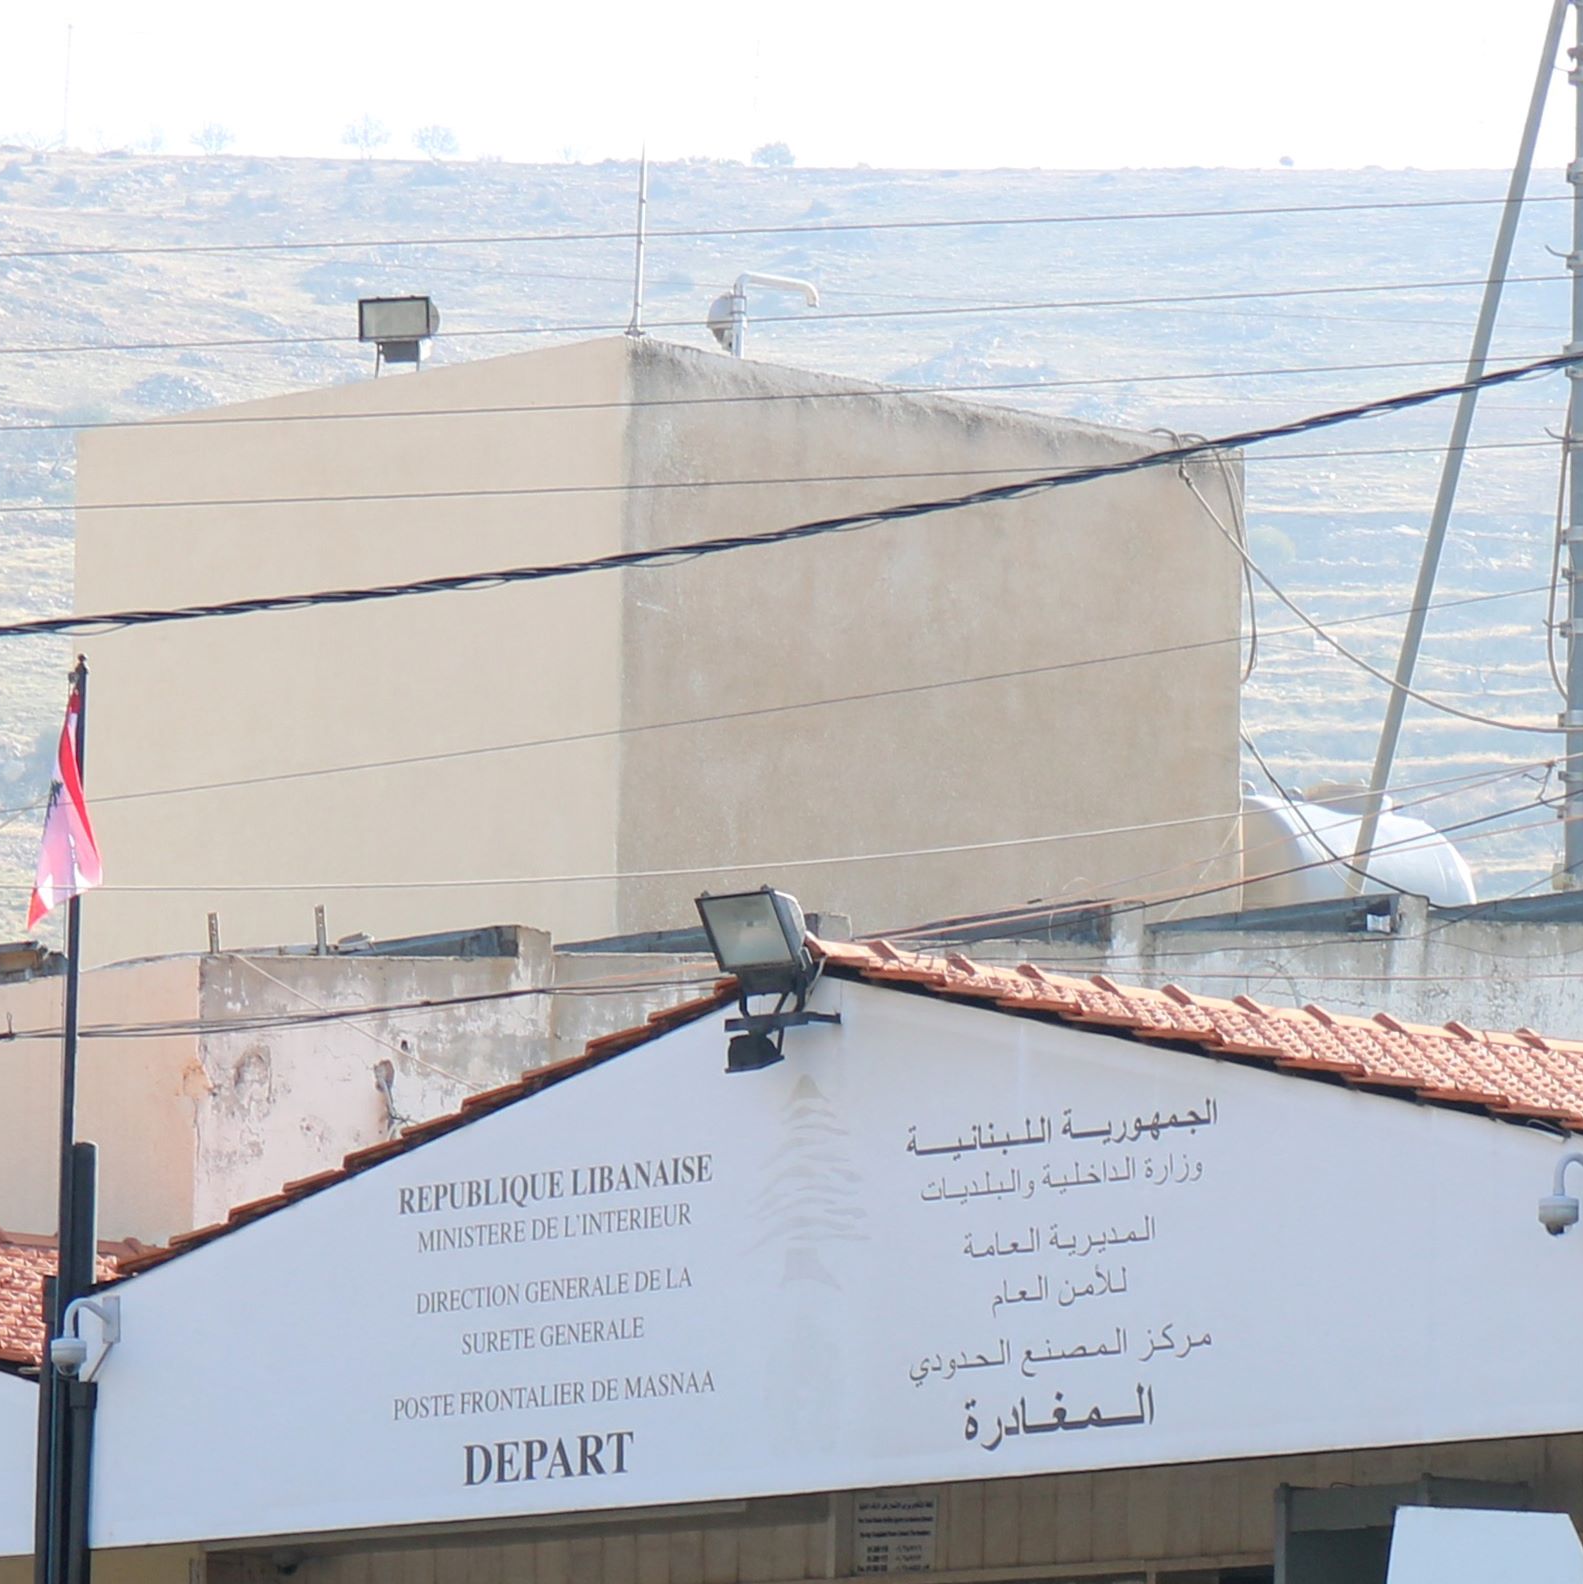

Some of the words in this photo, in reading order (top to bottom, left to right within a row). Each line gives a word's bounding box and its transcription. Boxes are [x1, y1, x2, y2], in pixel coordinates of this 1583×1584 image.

[905, 1115, 1052, 1161] اللبنانية
[1061, 1097, 1218, 1145] الجمهورية
[398, 1170, 565, 1216] REPUBLIQUE
[571, 1153, 713, 1197] LIBANAISE
[920, 1167, 1036, 1206] والبلديات
[1041, 1155, 1136, 1195] الداخلية
[1144, 1152, 1204, 1186] وزارة
[417, 1220, 526, 1254] MINISTERE
[531, 1217, 559, 1242] DE
[565, 1202, 692, 1238] L'INTERIEUR
[963, 1226, 1041, 1259] العامة
[1049, 1214, 1156, 1257] المديرية
[416, 1282, 520, 1315] DIRECTION
[525, 1272, 630, 1305] GENERALE
[634, 1268, 661, 1294] DE
[666, 1266, 693, 1291] LA
[991, 1274, 1049, 1319] العام
[1057, 1263, 1128, 1307] للأمن
[462, 1327, 536, 1356] SURETE
[540, 1316, 645, 1348] GENERALE
[1020, 1326, 1127, 1378] المصنع
[1138, 1322, 1213, 1362] مركز
[908, 1338, 1011, 1389] الحدودي
[393, 1393, 456, 1421] POSTE
[460, 1382, 586, 1416] FRONTALIER
[591, 1378, 618, 1403] DE
[624, 1370, 716, 1400] MASNAA
[964, 1382, 1155, 1452] المغادرة
[463, 1431, 635, 1487] DEPART
